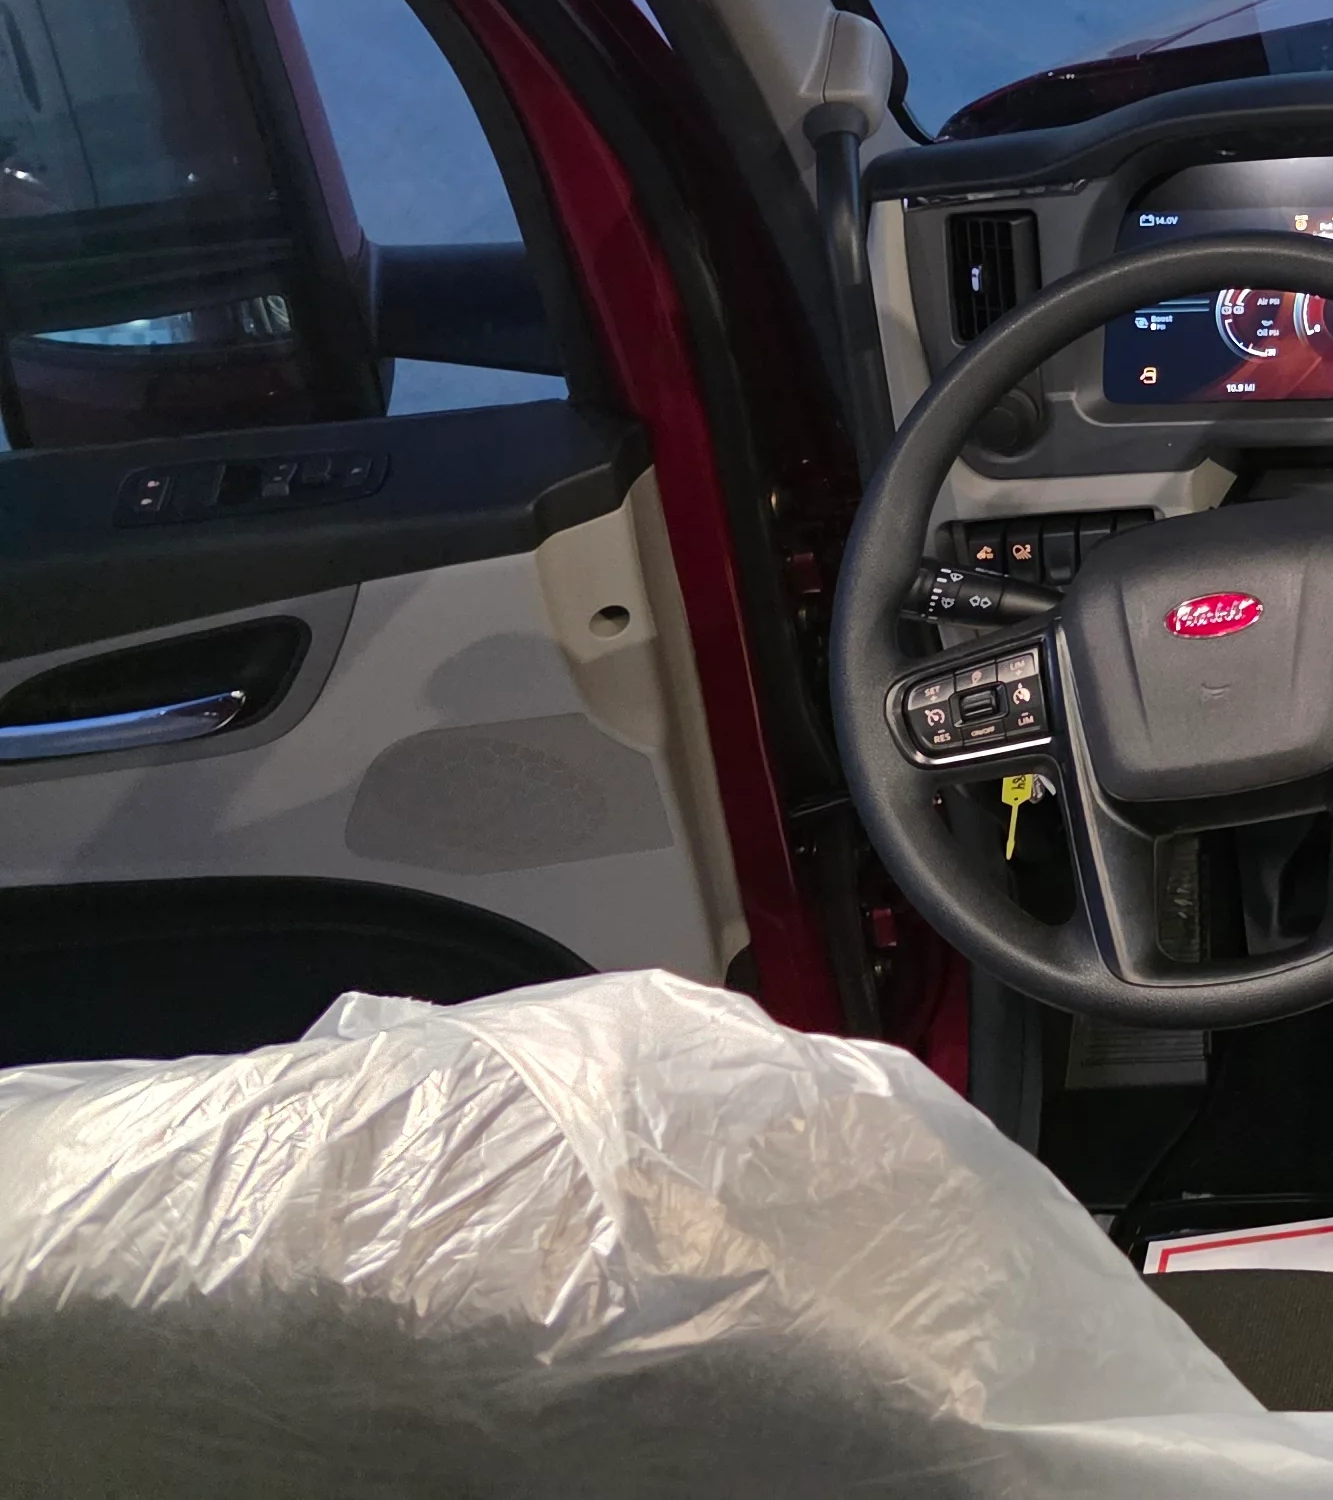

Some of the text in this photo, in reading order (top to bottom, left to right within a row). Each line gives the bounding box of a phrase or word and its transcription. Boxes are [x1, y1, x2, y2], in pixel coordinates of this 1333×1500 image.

[1155, 216, 1179, 225] 14.0V
[1257, 297, 1269, 306] Air
[1256, 328, 1268, 337] Oil
[1009, 660, 1026, 671] LIM
[923, 685, 941, 697] SET
[1017, 714, 1035, 727] LIM
[932, 732, 951, 744] RES
